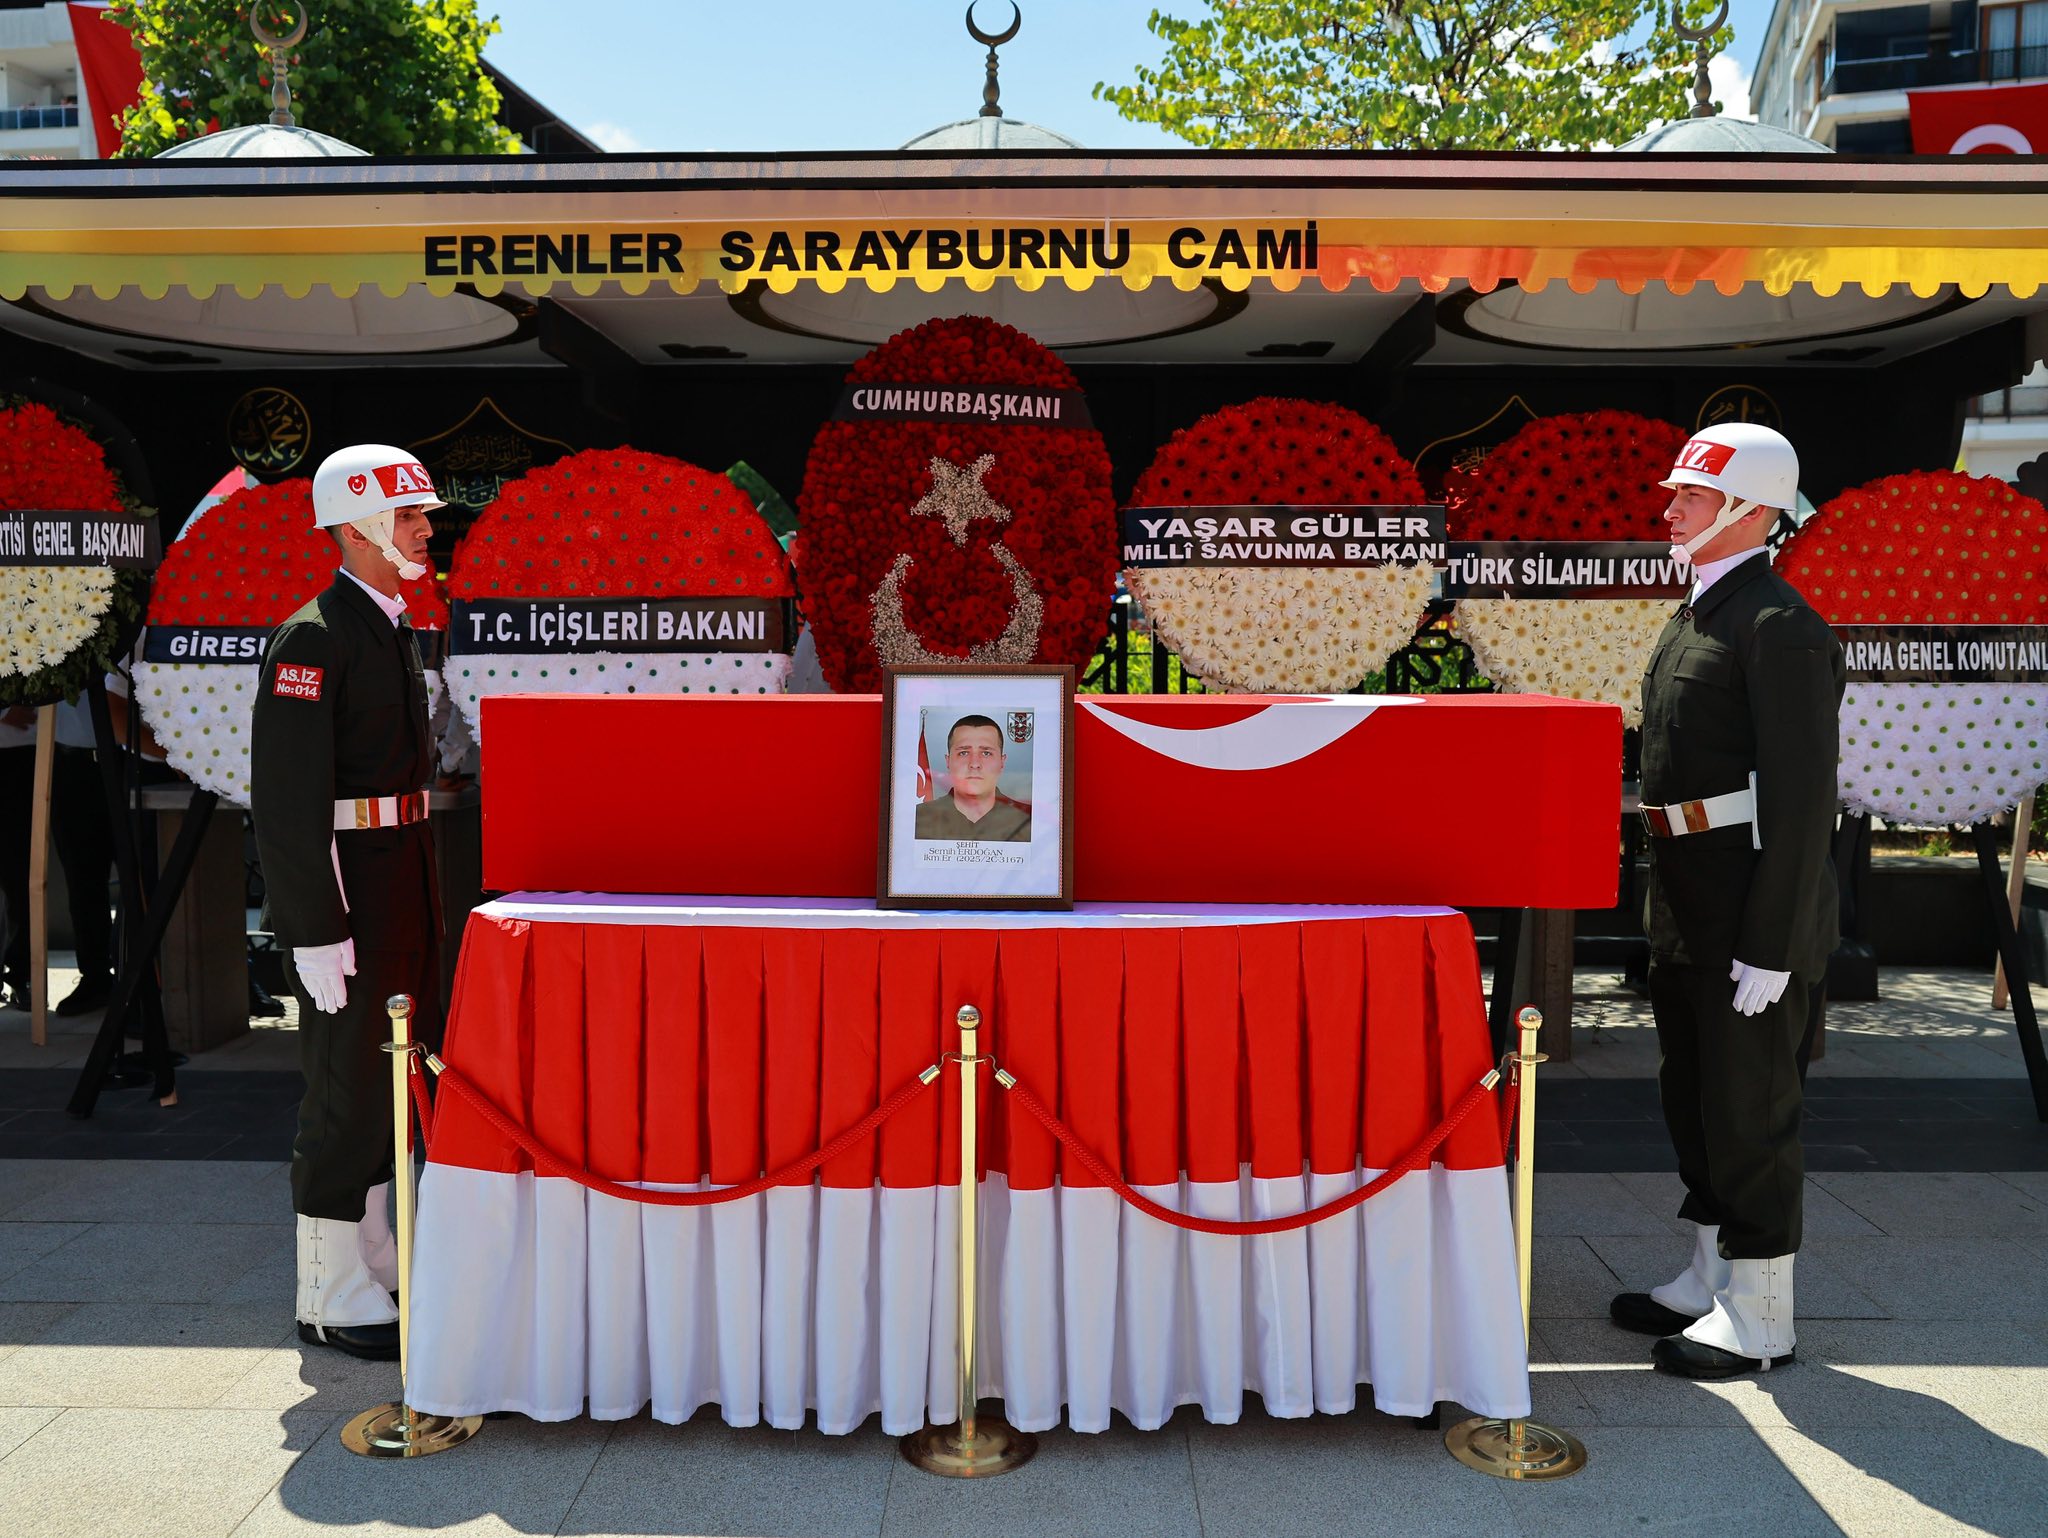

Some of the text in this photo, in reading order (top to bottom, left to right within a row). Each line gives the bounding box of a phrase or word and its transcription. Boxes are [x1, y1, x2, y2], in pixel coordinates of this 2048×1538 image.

[424, 220, 1318, 276] ERENLER SARAYBURNU CAMİ
[852, 389, 1060, 421] CUMHURBAŞKANI
[33, 521, 75, 556] GENEL
[82, 522, 144, 565] BAŞKANI
[1139, 513, 1430, 542] YAŞAR GÜLER
[1201, 543, 1336, 560] SAVUNMA
[1344, 543, 1445, 560] BAKANI
[1447, 553, 1515, 585] TÜRK
[1521, 552, 1615, 585] SİLAHLI
[469, 603, 765, 646] T.C. İÇİŞLERİ BAKANI
[1839, 641, 1894, 671] ARMA
[1897, 641, 1954, 671] GENEL
[276, 682, 318, 697] No:014
[928, 847, 1003, 857] Semih ERDOĞAN
